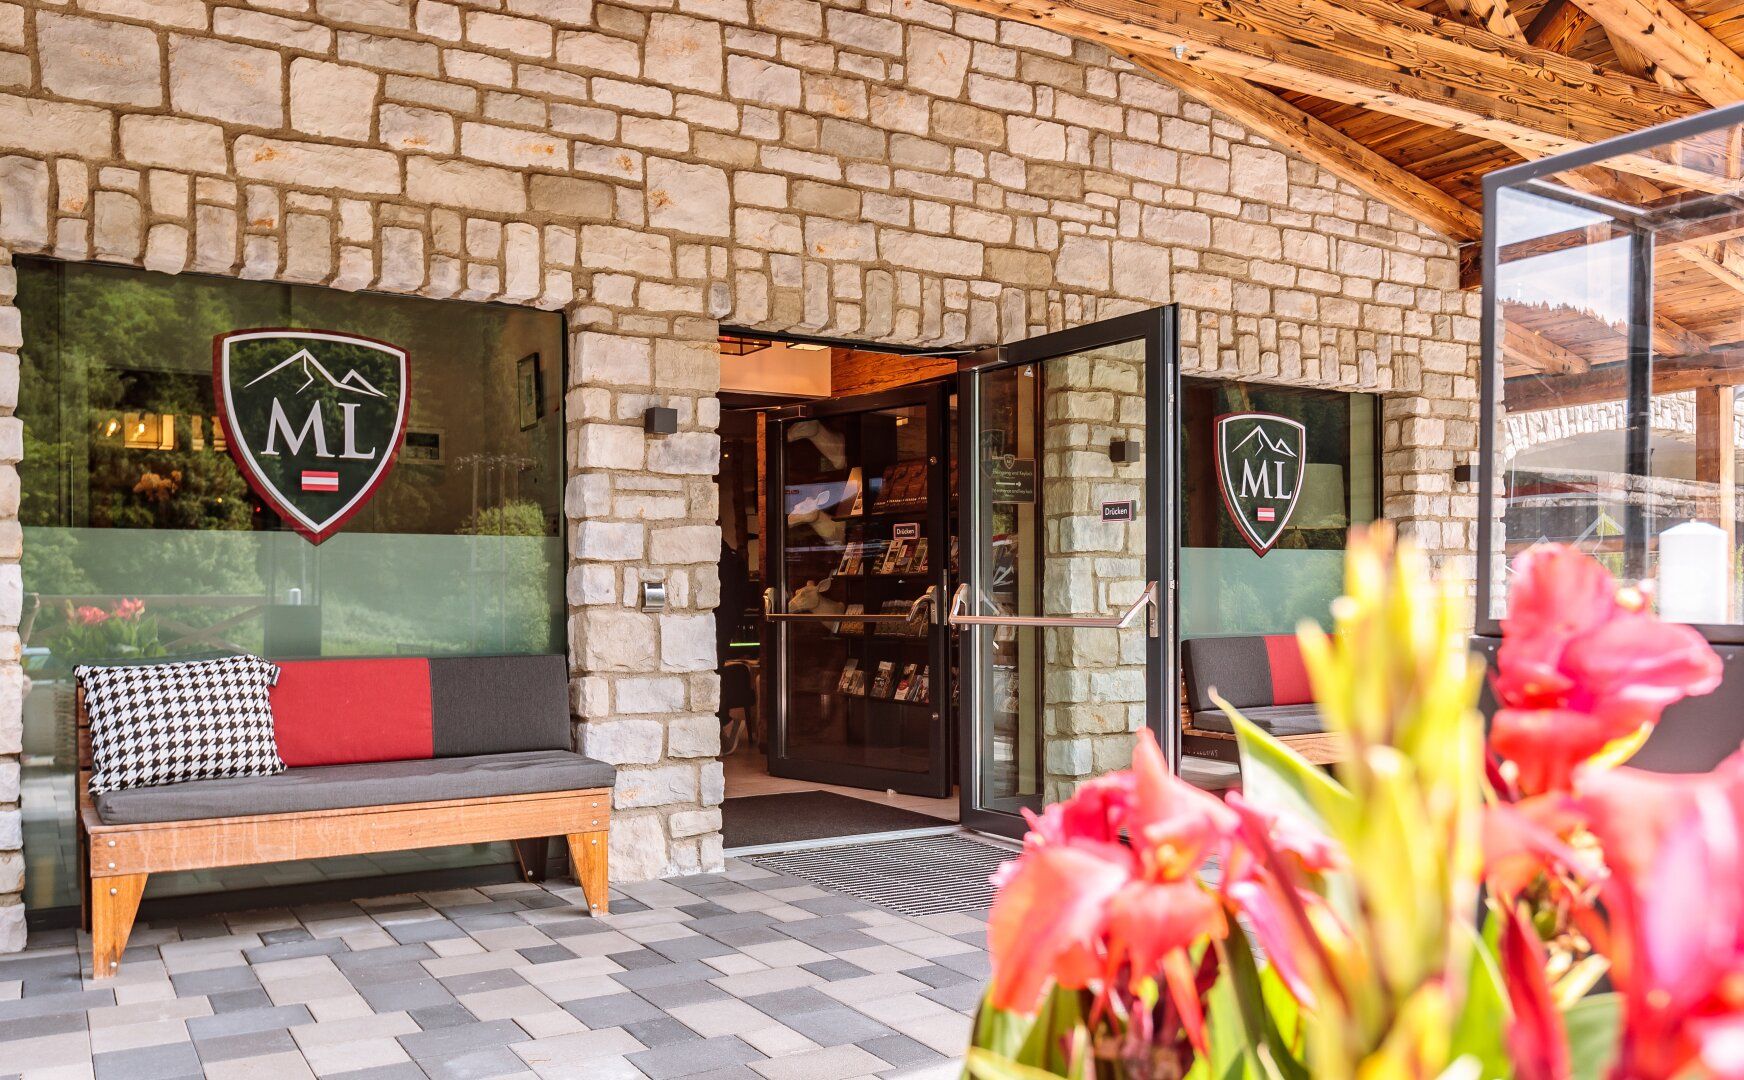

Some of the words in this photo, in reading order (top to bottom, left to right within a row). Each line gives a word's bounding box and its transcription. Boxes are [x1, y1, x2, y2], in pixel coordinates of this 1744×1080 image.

[260, 397, 375, 459] ML
[1239, 458, 1292, 500] ML
[1105, 507, 1128, 516] Drücken
[896, 527, 915, 535] Drücken
